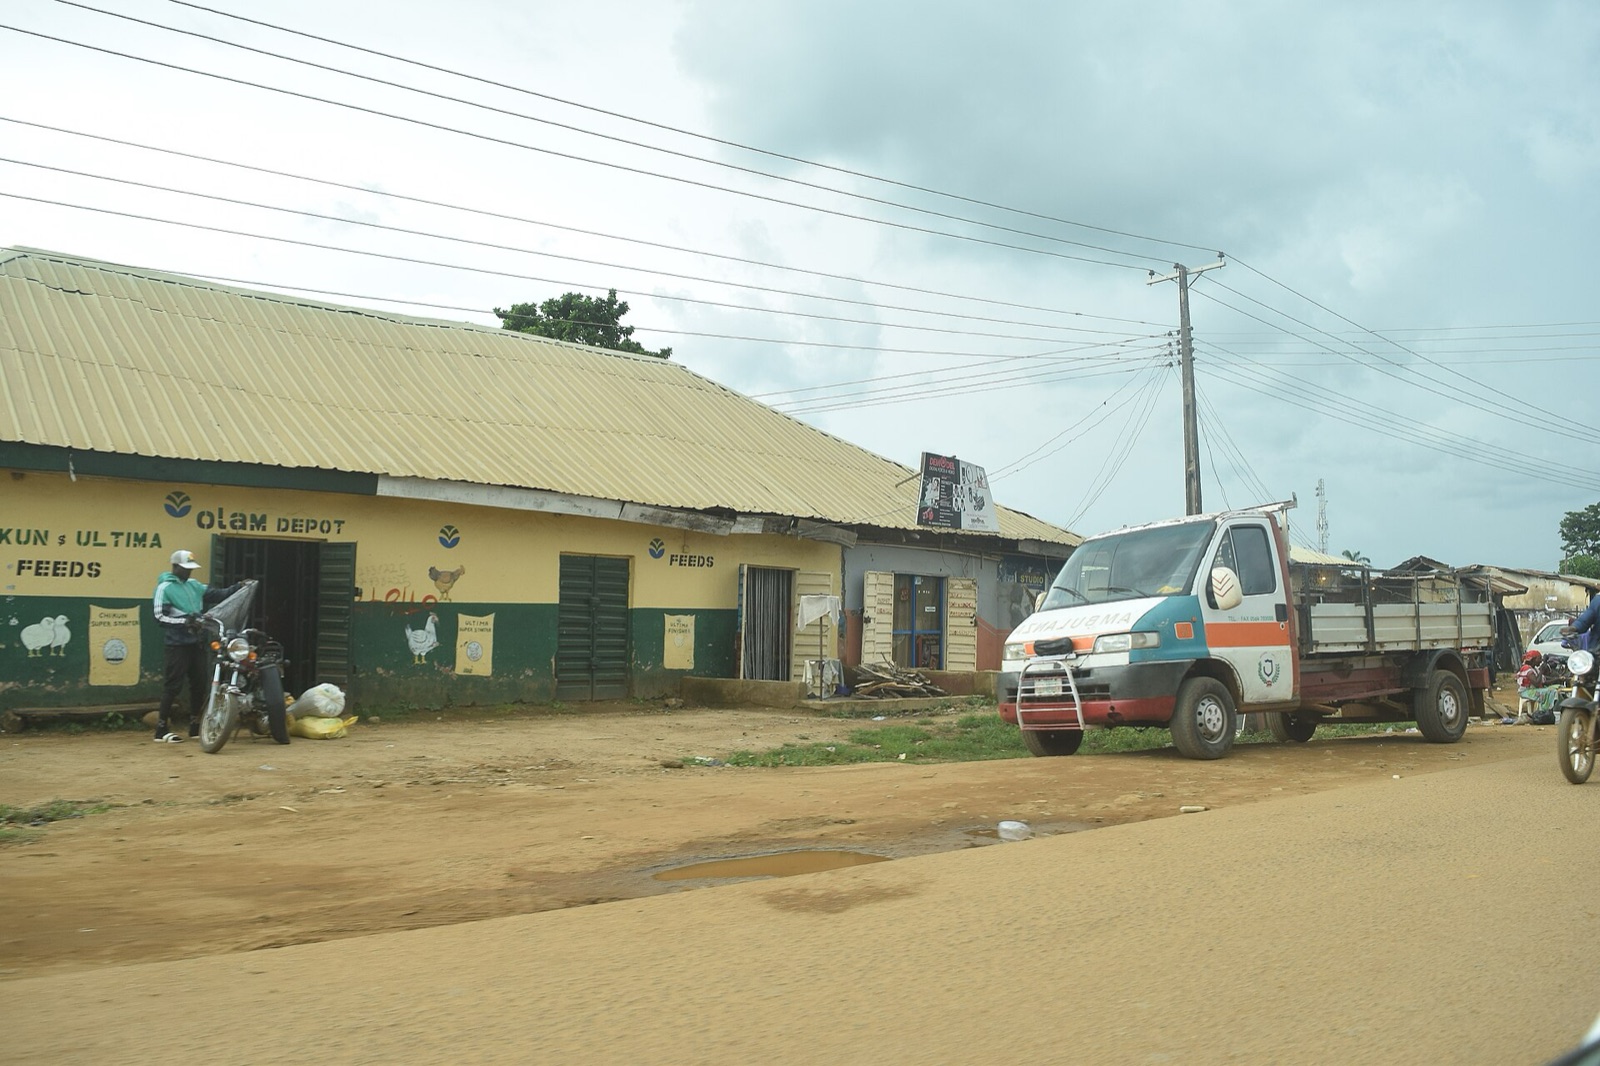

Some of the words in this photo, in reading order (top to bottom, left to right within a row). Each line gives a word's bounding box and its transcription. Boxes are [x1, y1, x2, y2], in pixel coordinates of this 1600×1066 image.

[277, 518, 345, 535] DEPOT
[76, 531, 163, 548] ULTIMA
[16, 560, 102, 578] FEEDS
[670, 554, 714, 568] FEEDS
[1020, 575, 1044, 584] STUDIO
